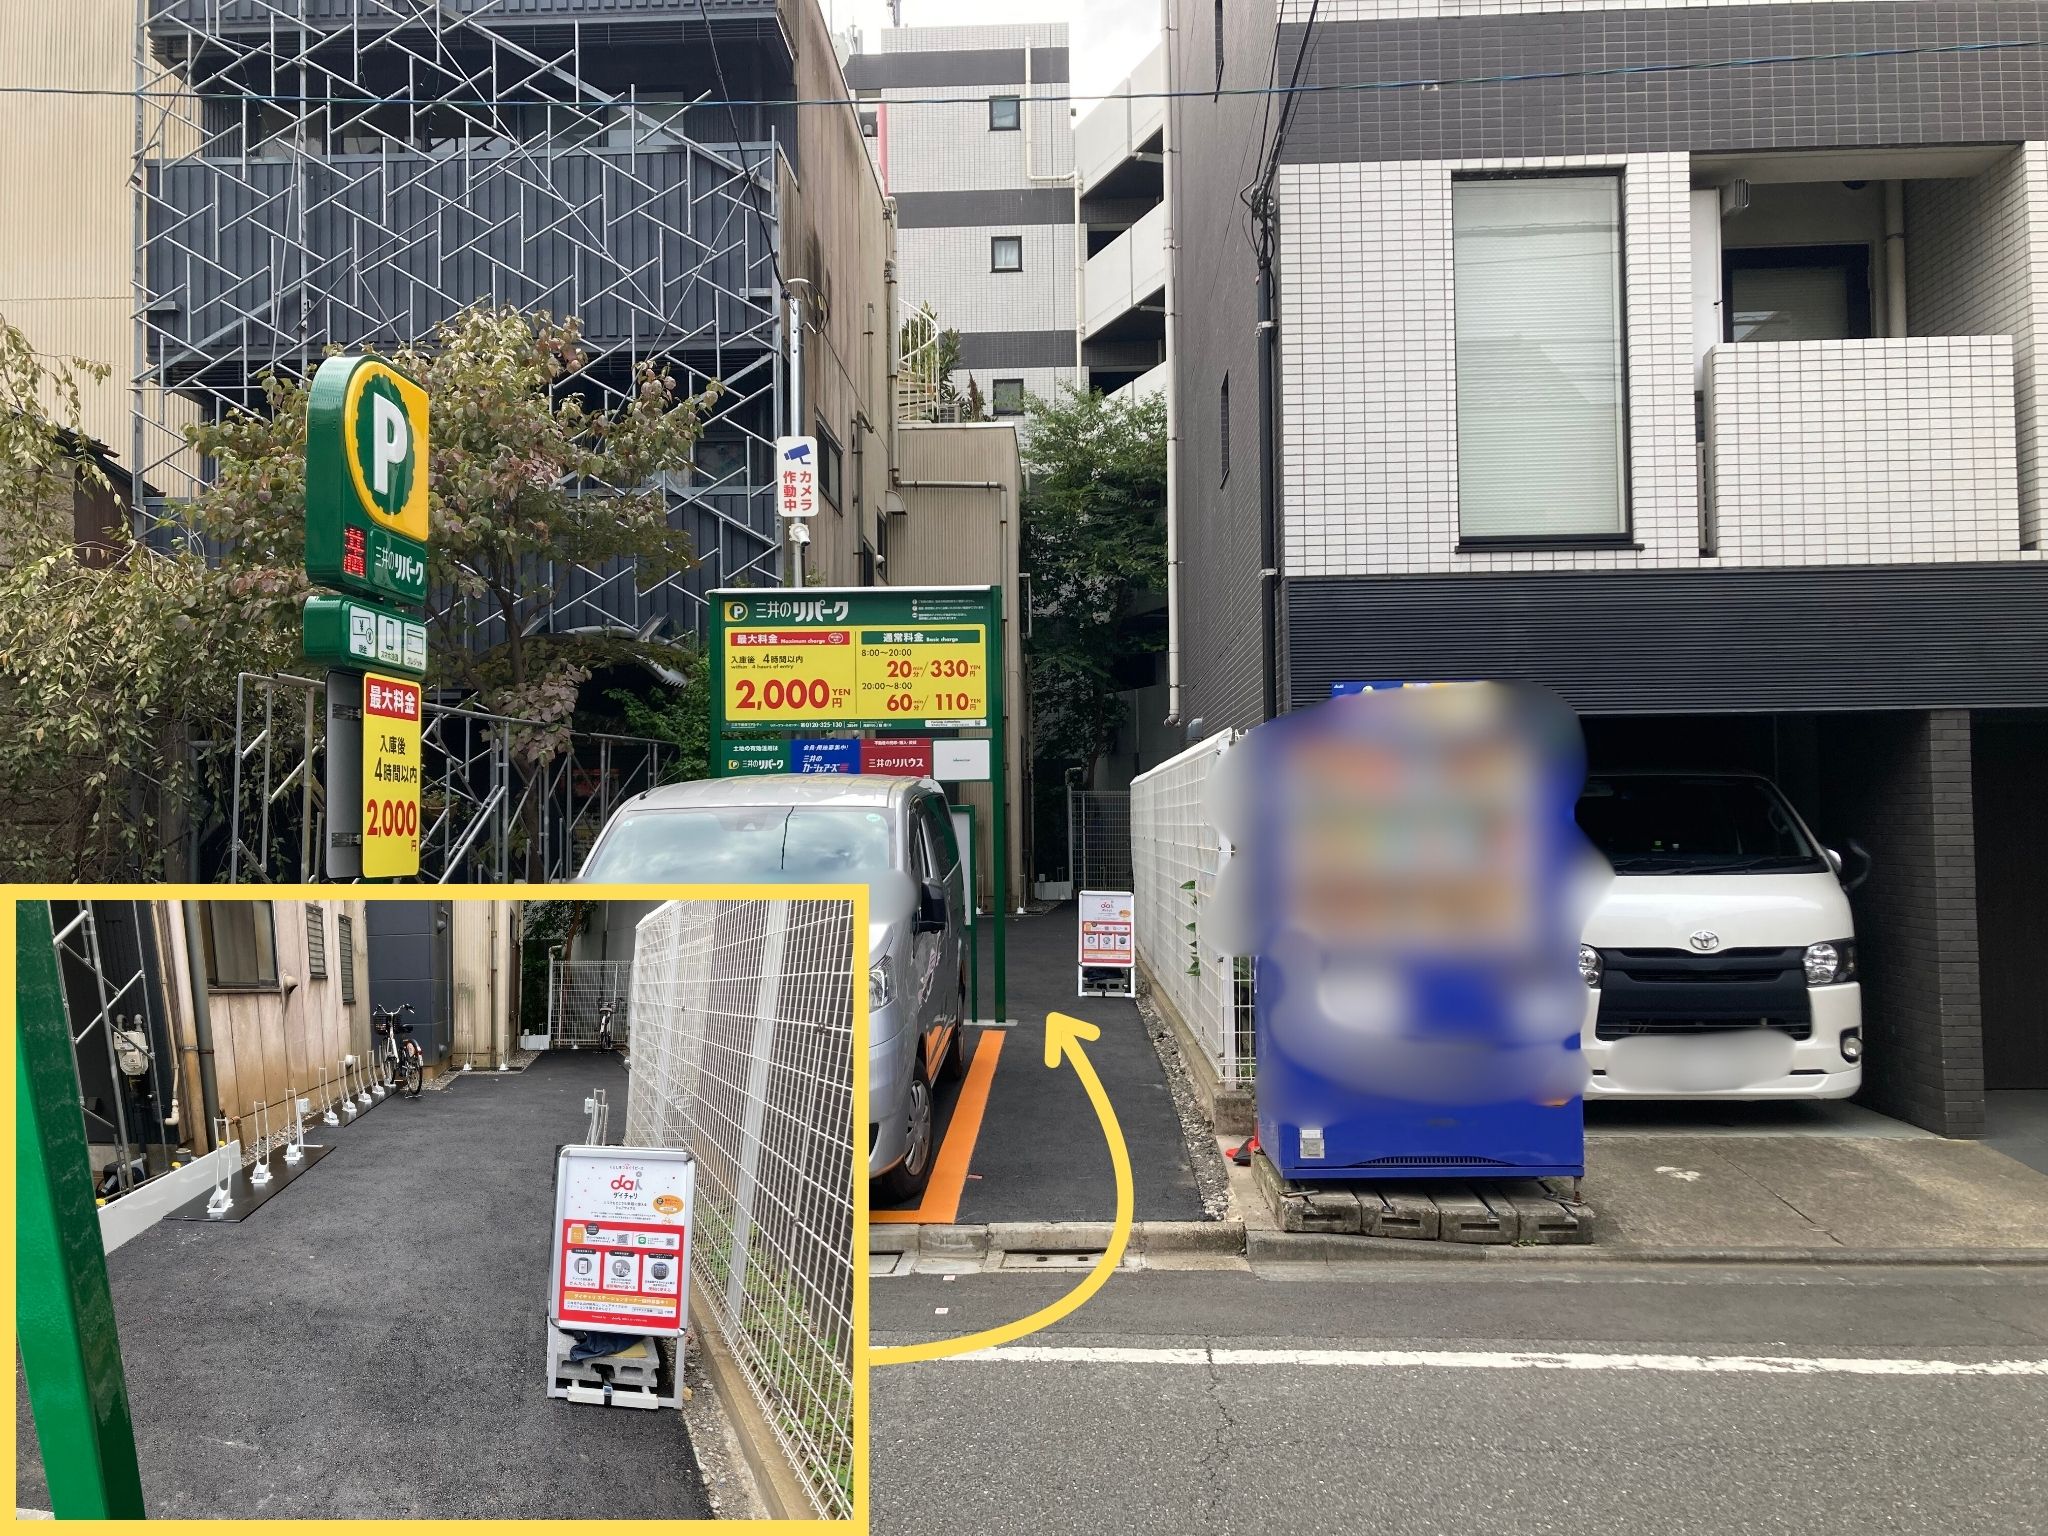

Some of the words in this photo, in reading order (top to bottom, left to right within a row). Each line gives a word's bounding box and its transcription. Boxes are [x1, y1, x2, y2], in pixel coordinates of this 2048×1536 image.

[373, 392, 408, 495] P
[783, 470, 797, 511] 作動中
[799, 470, 813, 511] カメラ
[375, 546, 424, 586] 三井のリパーク
[756, 600, 849, 622] 三井のリパーク
[737, 633, 778, 644] 最大料金
[883, 632, 924, 643] 通常料金
[730, 655, 756, 664] 入庫後
[762, 653, 804, 664] 4時間以内
[886, 660, 912, 678] 20
[930, 659, 969, 678] 330
[369, 684, 416, 715] 最大料金
[735, 678, 830, 711] 2,000
[832, 688, 851, 696] YEN
[935, 692, 969, 711] 110
[832, 697, 842, 708] 円
[886, 693, 912, 711] 60
[379, 734, 406, 756] 入庫後
[374, 757, 418, 784] 4時間以内
[742, 758, 784, 770] 三井のリパーク
[868, 758, 924, 768] 三井のリハウス
[366, 798, 417, 838] 2,000
[410, 839, 417, 852] 円
[613, 1192, 638, 1200] ダイチャリ
